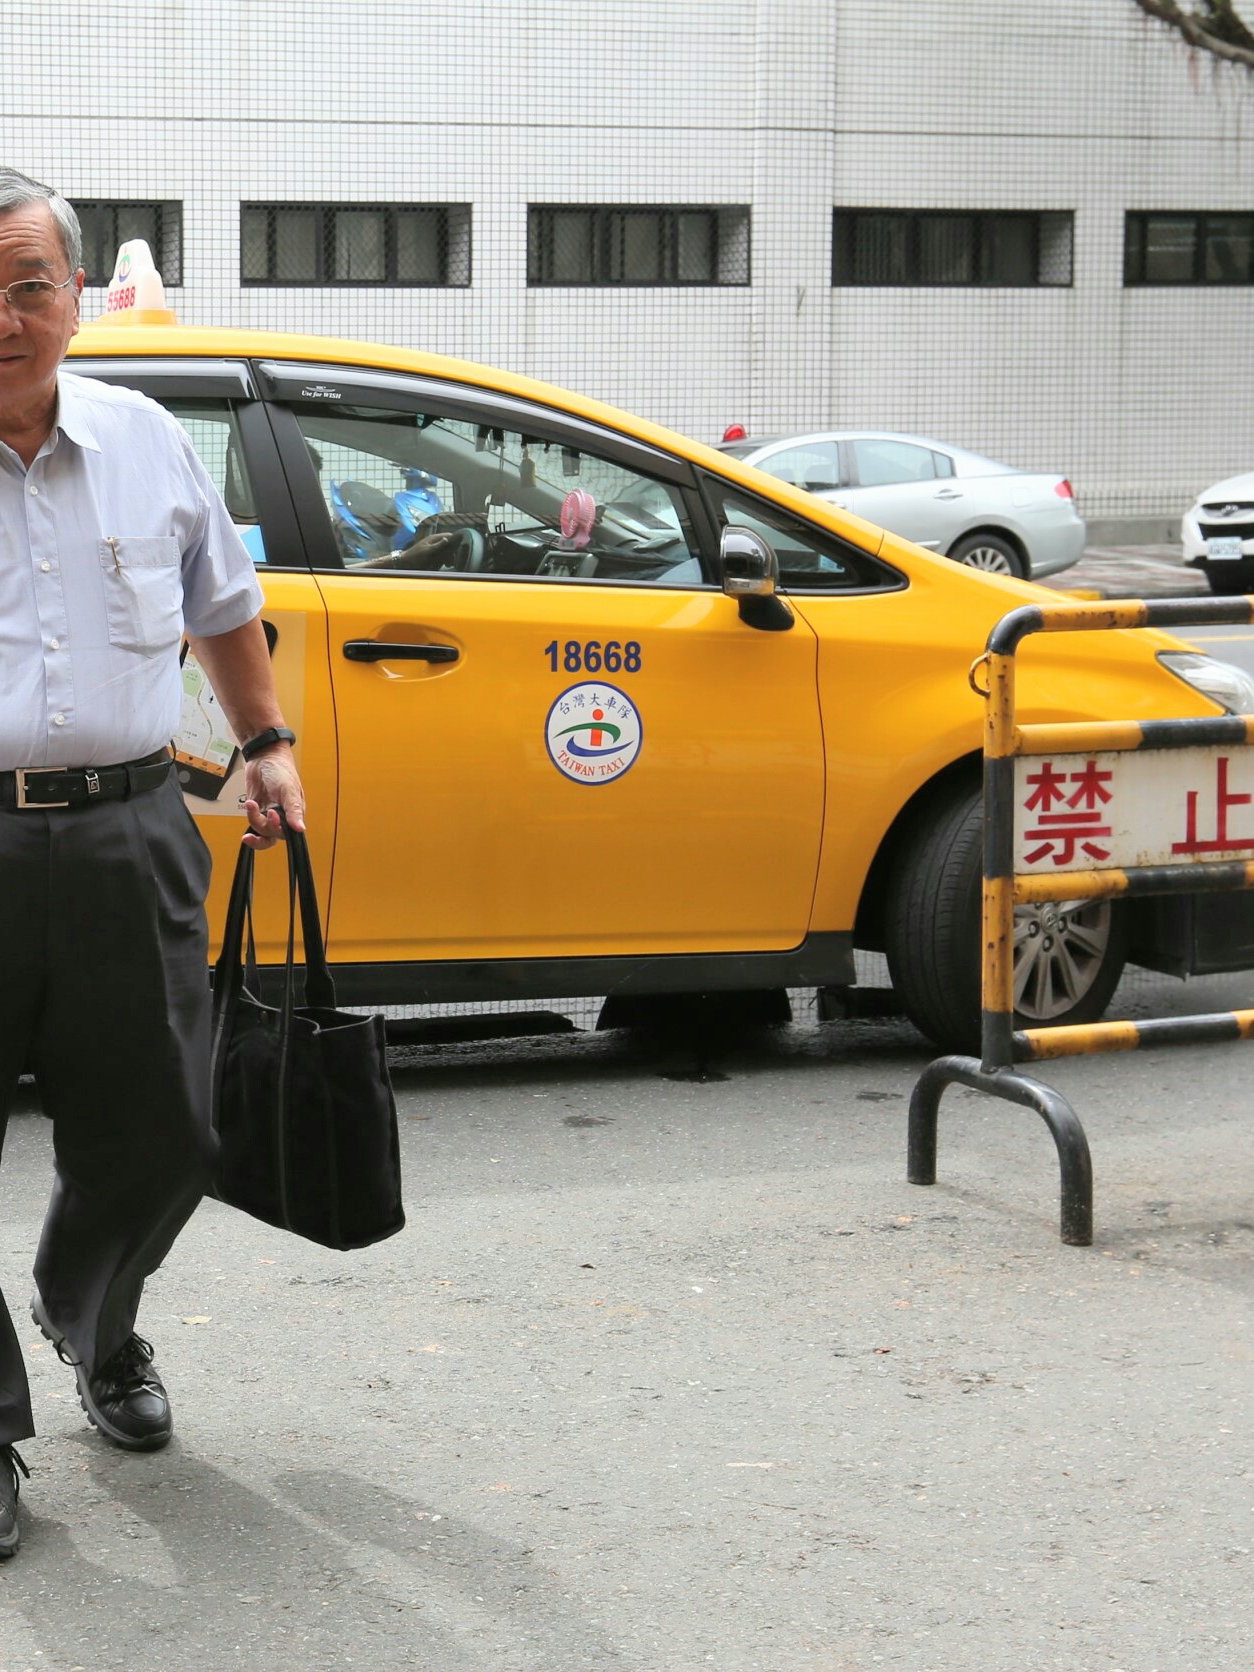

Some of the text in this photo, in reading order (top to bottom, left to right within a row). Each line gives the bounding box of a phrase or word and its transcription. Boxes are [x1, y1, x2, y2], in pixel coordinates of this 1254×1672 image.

[107, 286, 136, 313] 55688
[544, 640, 642, 673] 18668
[559, 692, 633, 720] 台灣大車隊
[557, 749, 626, 777] TAIWAN TAXI
[1023, 757, 1254, 866] 禁止
